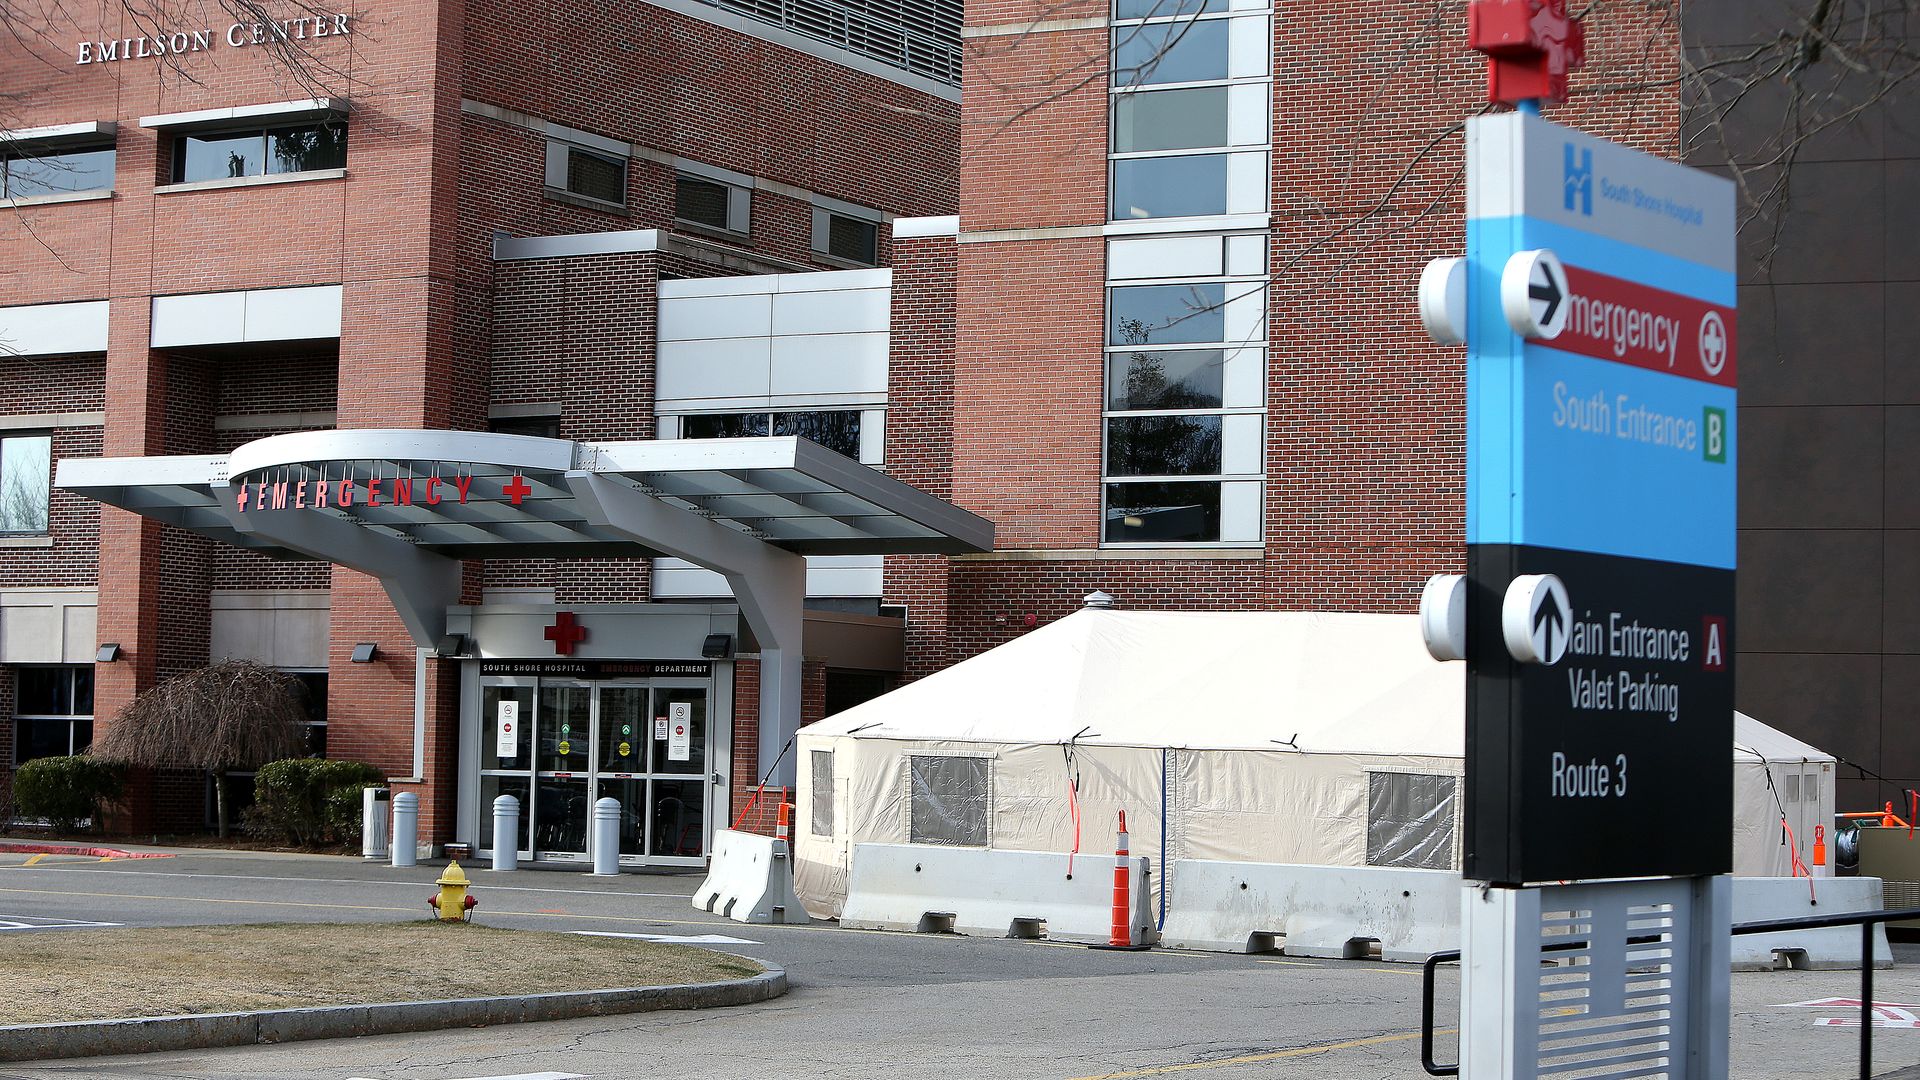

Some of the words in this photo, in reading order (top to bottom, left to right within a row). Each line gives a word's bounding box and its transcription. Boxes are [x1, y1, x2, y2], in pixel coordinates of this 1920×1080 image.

[76, 29, 212, 64] EMILSON
[226, 13, 350, 47] CENTER
[1600, 176, 1630, 203] South
[1632, 187, 1662, 213] Shore
[1664, 196, 1704, 226] Hospital
[1564, 293, 1680, 368] mergency
[1553, 381, 1610, 434] South
[1616, 394, 1696, 450] Entrance
[1708, 413, 1721, 455] B
[256, 475, 473, 511] EMERGENCY
[1568, 608, 1603, 656] ain
[1609, 612, 1690, 662] Entrance
[1706, 623, 1721, 666] A
[483, 664, 510, 672] SOUTH
[513, 664, 541, 672] SHORE
[544, 664, 586, 672] HOSPITAL
[600, 664, 651, 673] EMERGENCY
[655, 665, 708, 673] DEPARTMENT
[1568, 667, 1614, 710] Valet
[1618, 670, 1679, 723] Parking
[1552, 751, 1609, 798] Route
[1615, 753, 1627, 797] 3
